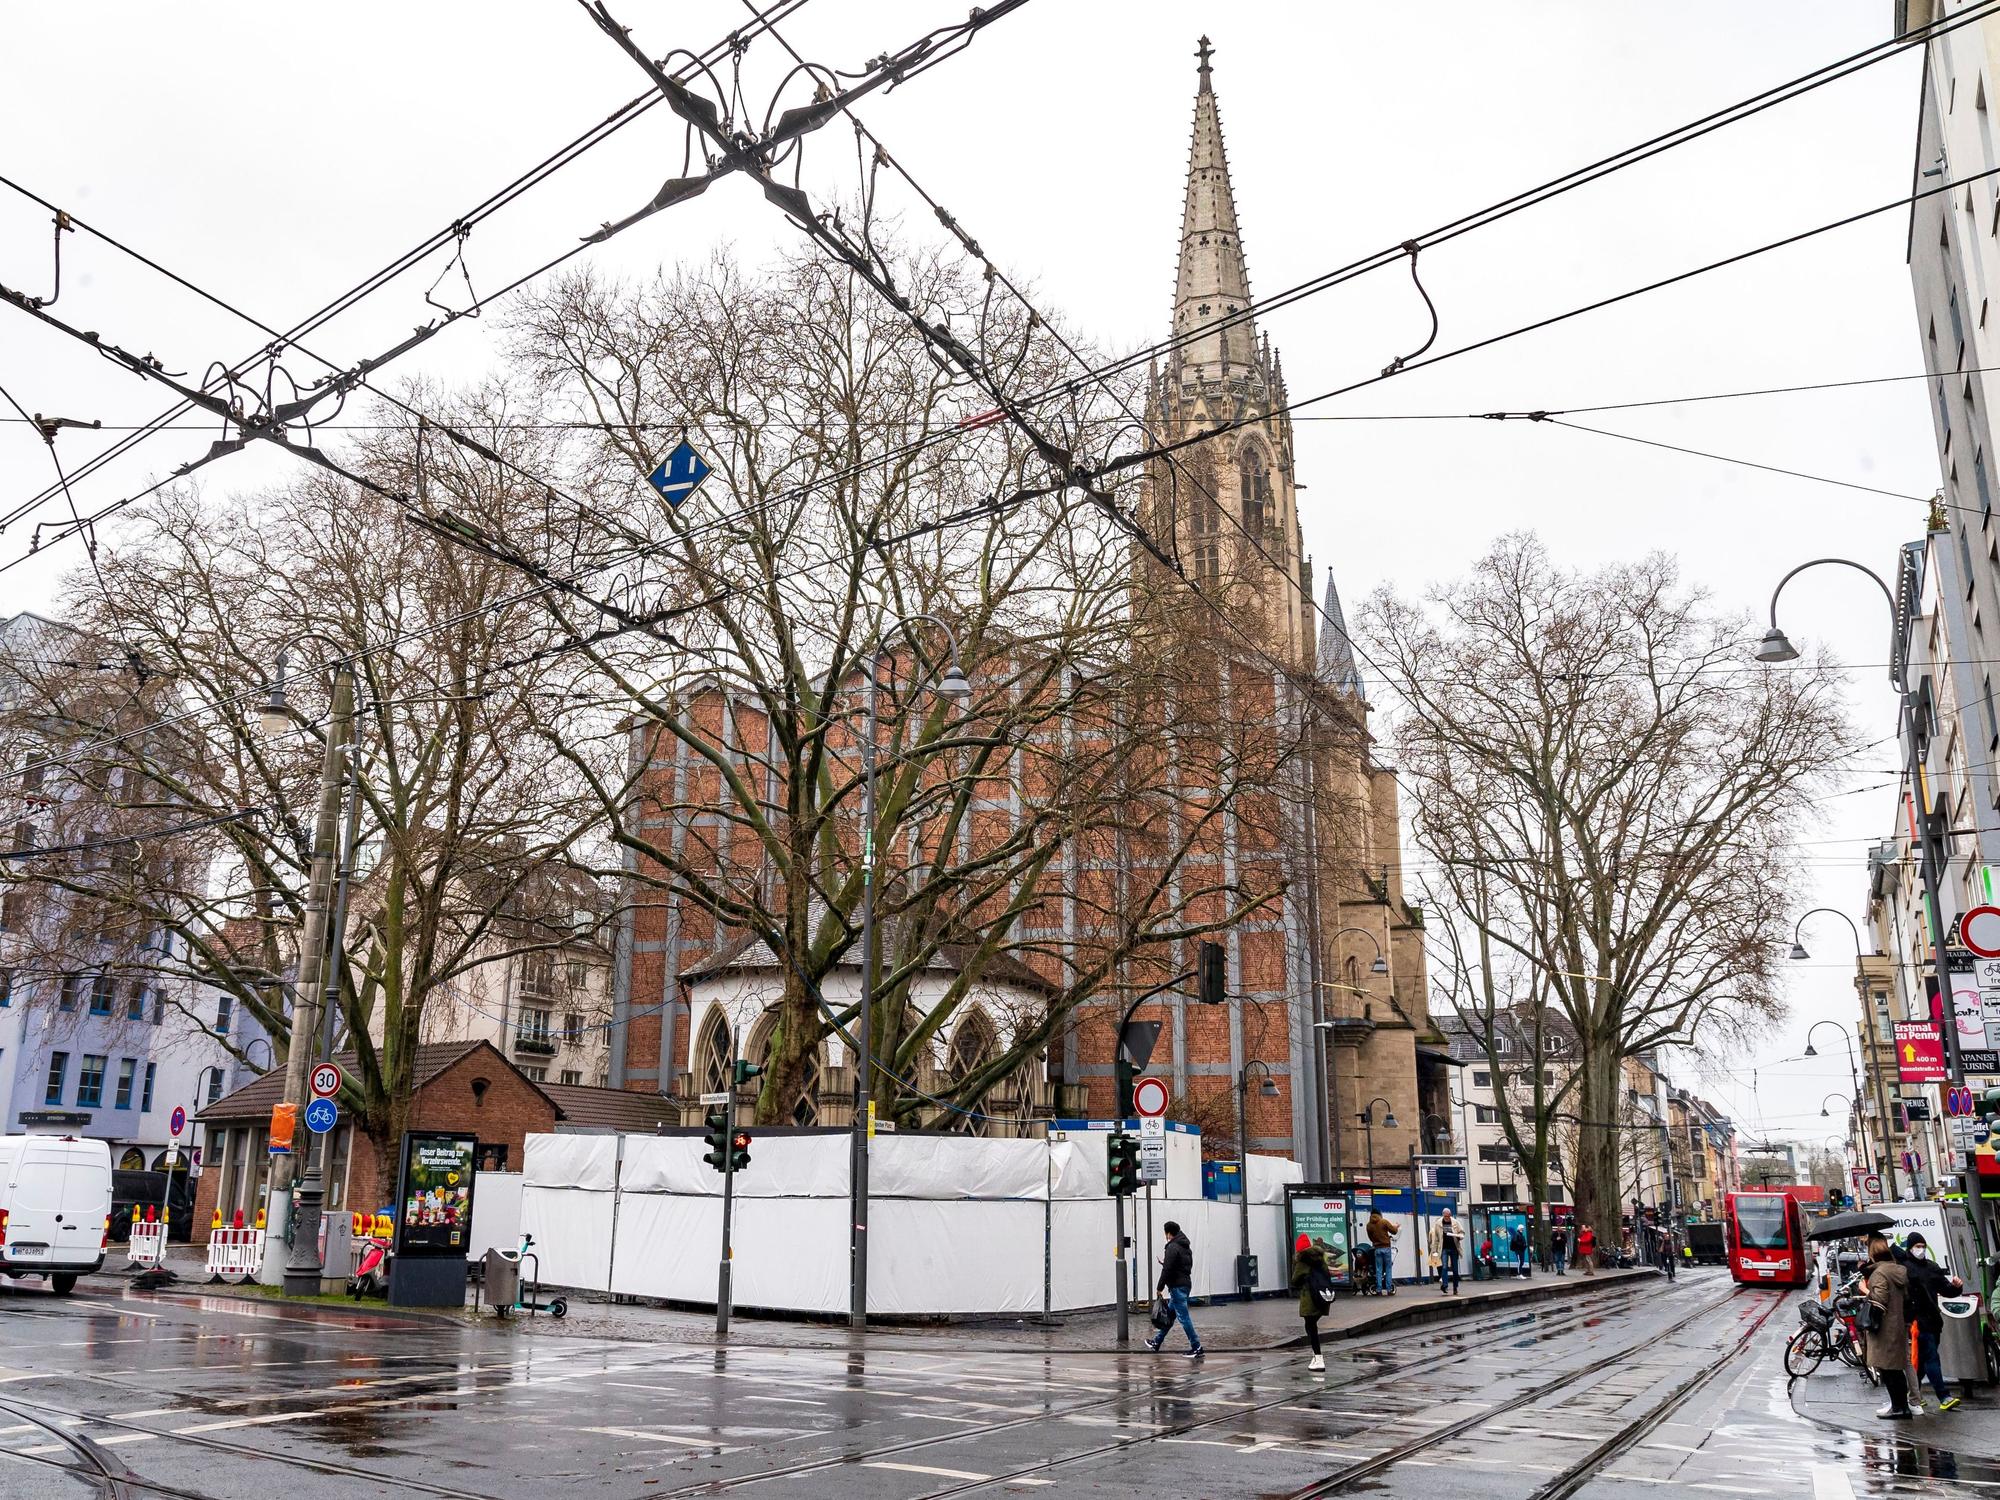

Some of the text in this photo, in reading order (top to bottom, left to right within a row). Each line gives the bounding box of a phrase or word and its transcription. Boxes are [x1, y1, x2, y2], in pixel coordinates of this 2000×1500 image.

[1894, 1023, 1932, 1032] Erstmal
[1908, 1032, 1940, 1041] Penny
[1960, 1053, 1997, 1061] APANESE
[316, 1072, 335, 1088] 30
[1973, 1123, 1989, 1131] affel
[420, 1147, 436, 1156] Unser
[436, 1148, 455, 1158] Beitrag
[1894, 1218, 1935, 1227] MICA.de
